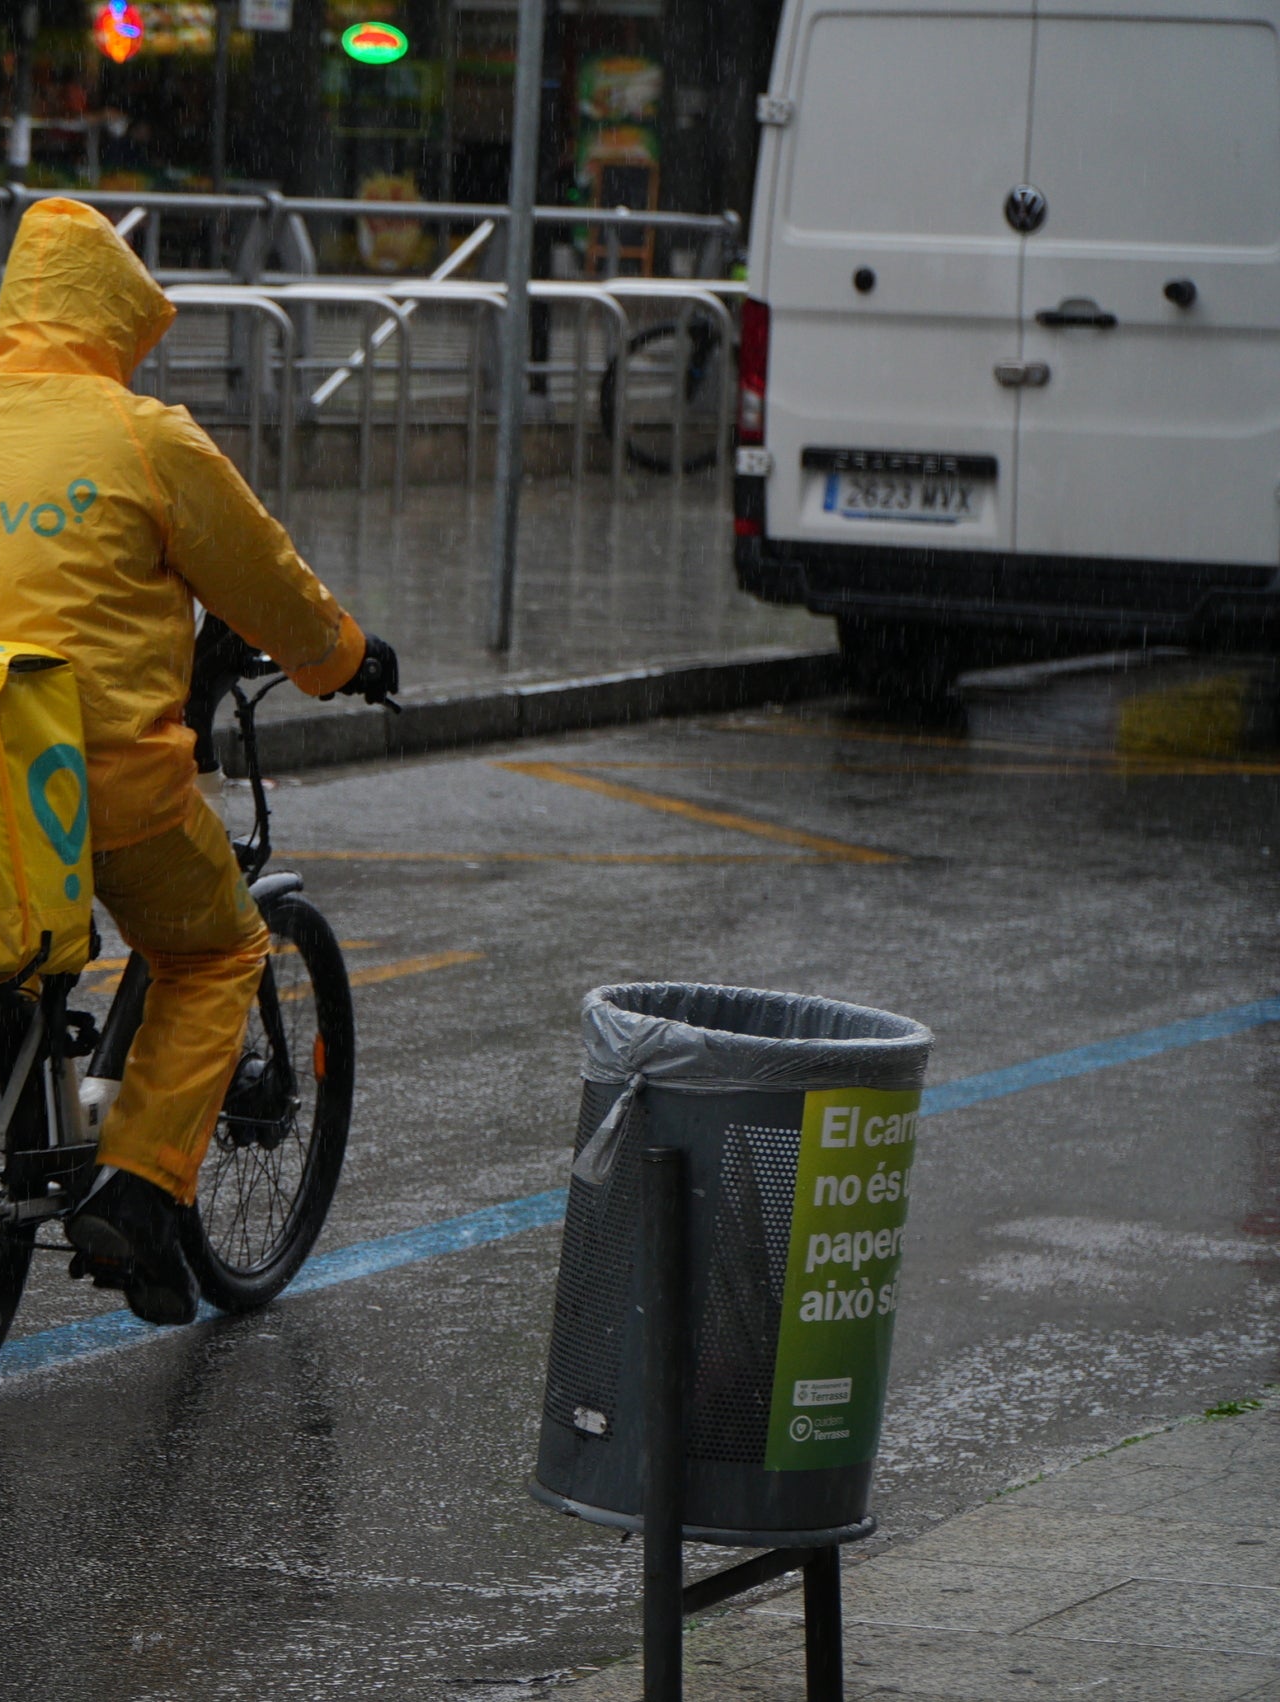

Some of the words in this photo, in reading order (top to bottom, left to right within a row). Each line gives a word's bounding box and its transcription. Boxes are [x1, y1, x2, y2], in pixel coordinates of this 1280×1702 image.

[820, 1105, 861, 1149] El
[863, 1110, 919, 1147] carr
[813, 1173, 862, 1207] no
[866, 1161, 902, 1204] és
[798, 1276, 875, 1323] això
[810, 1391, 849, 1402] Terrassa
[813, 1429, 851, 1441] Terrassa
